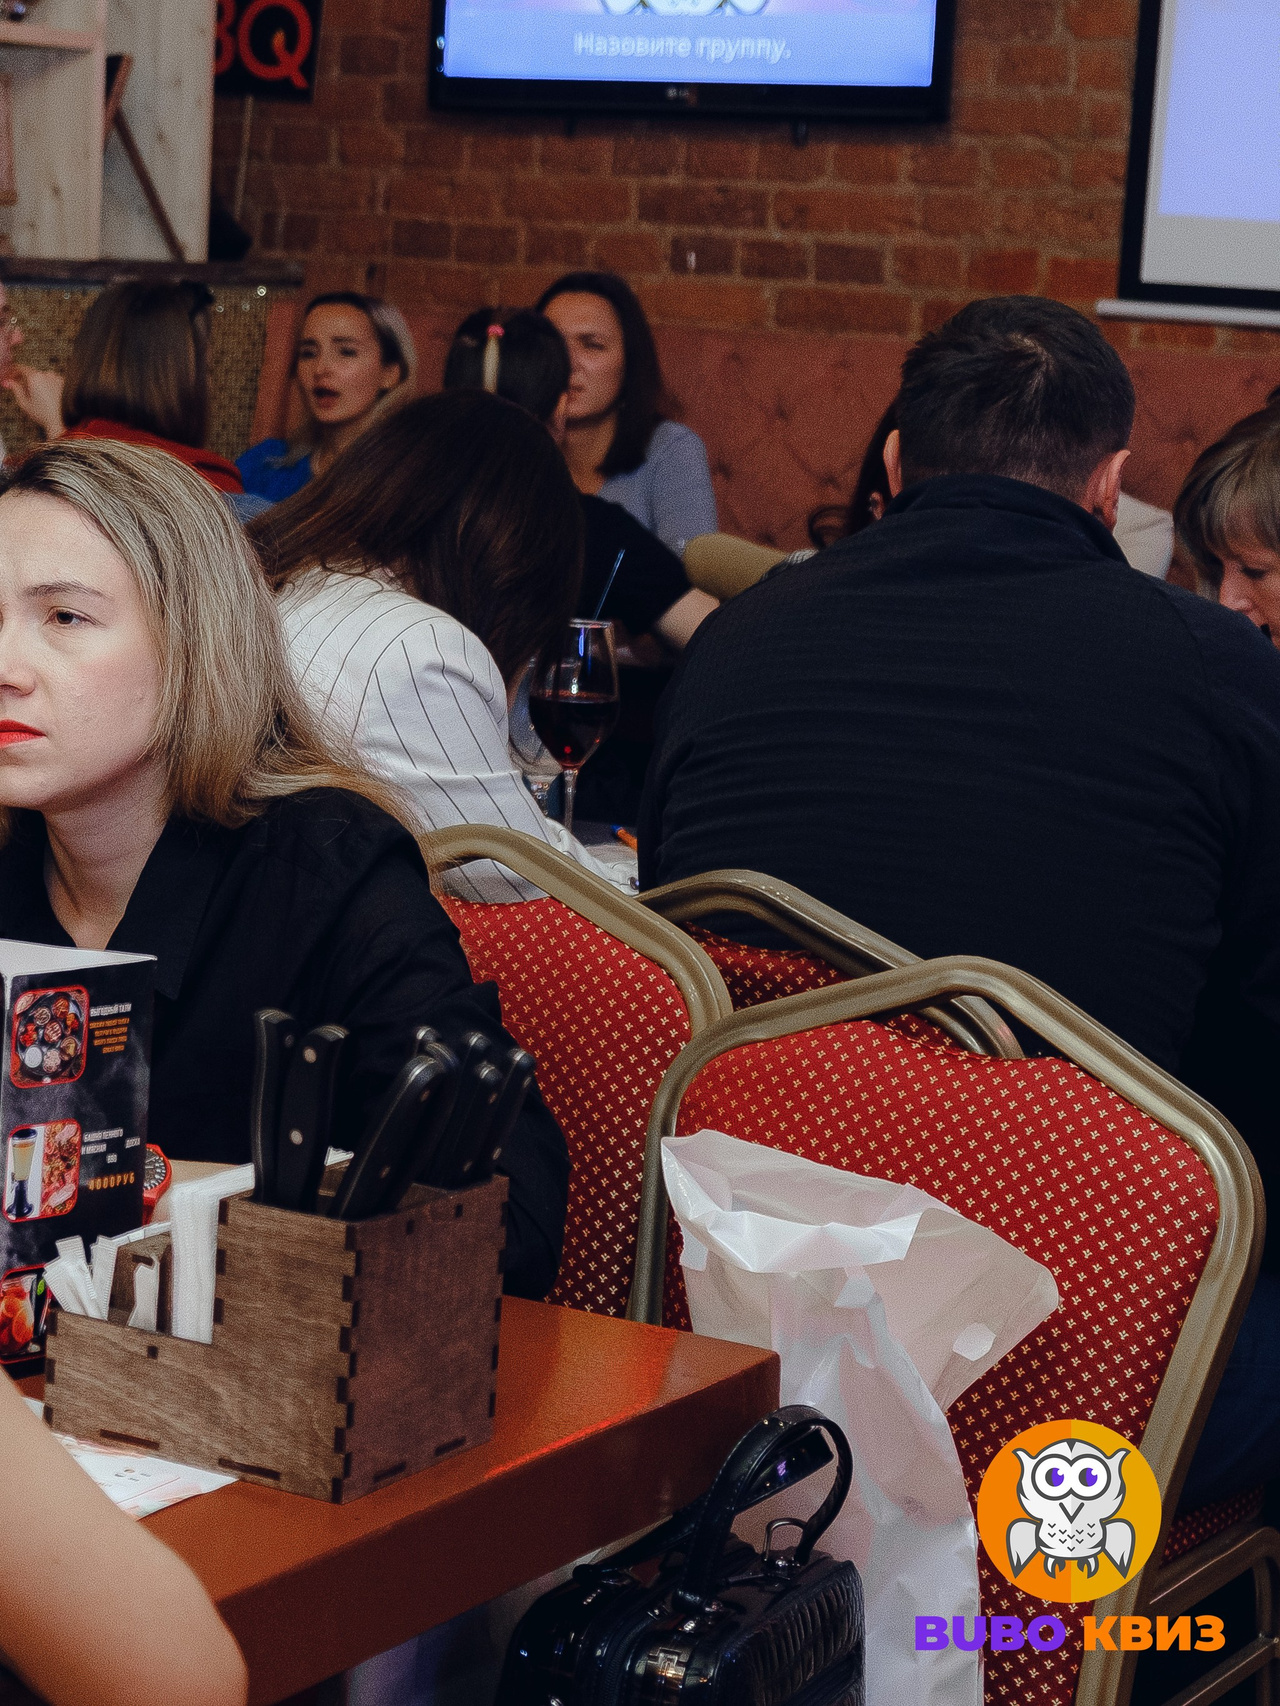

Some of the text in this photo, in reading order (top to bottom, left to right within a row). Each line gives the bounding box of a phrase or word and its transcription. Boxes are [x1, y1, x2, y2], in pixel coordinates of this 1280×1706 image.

[574, 32, 792, 64] Назовите группу.
[89, 1173, 134, 1190] 4000РУБ
